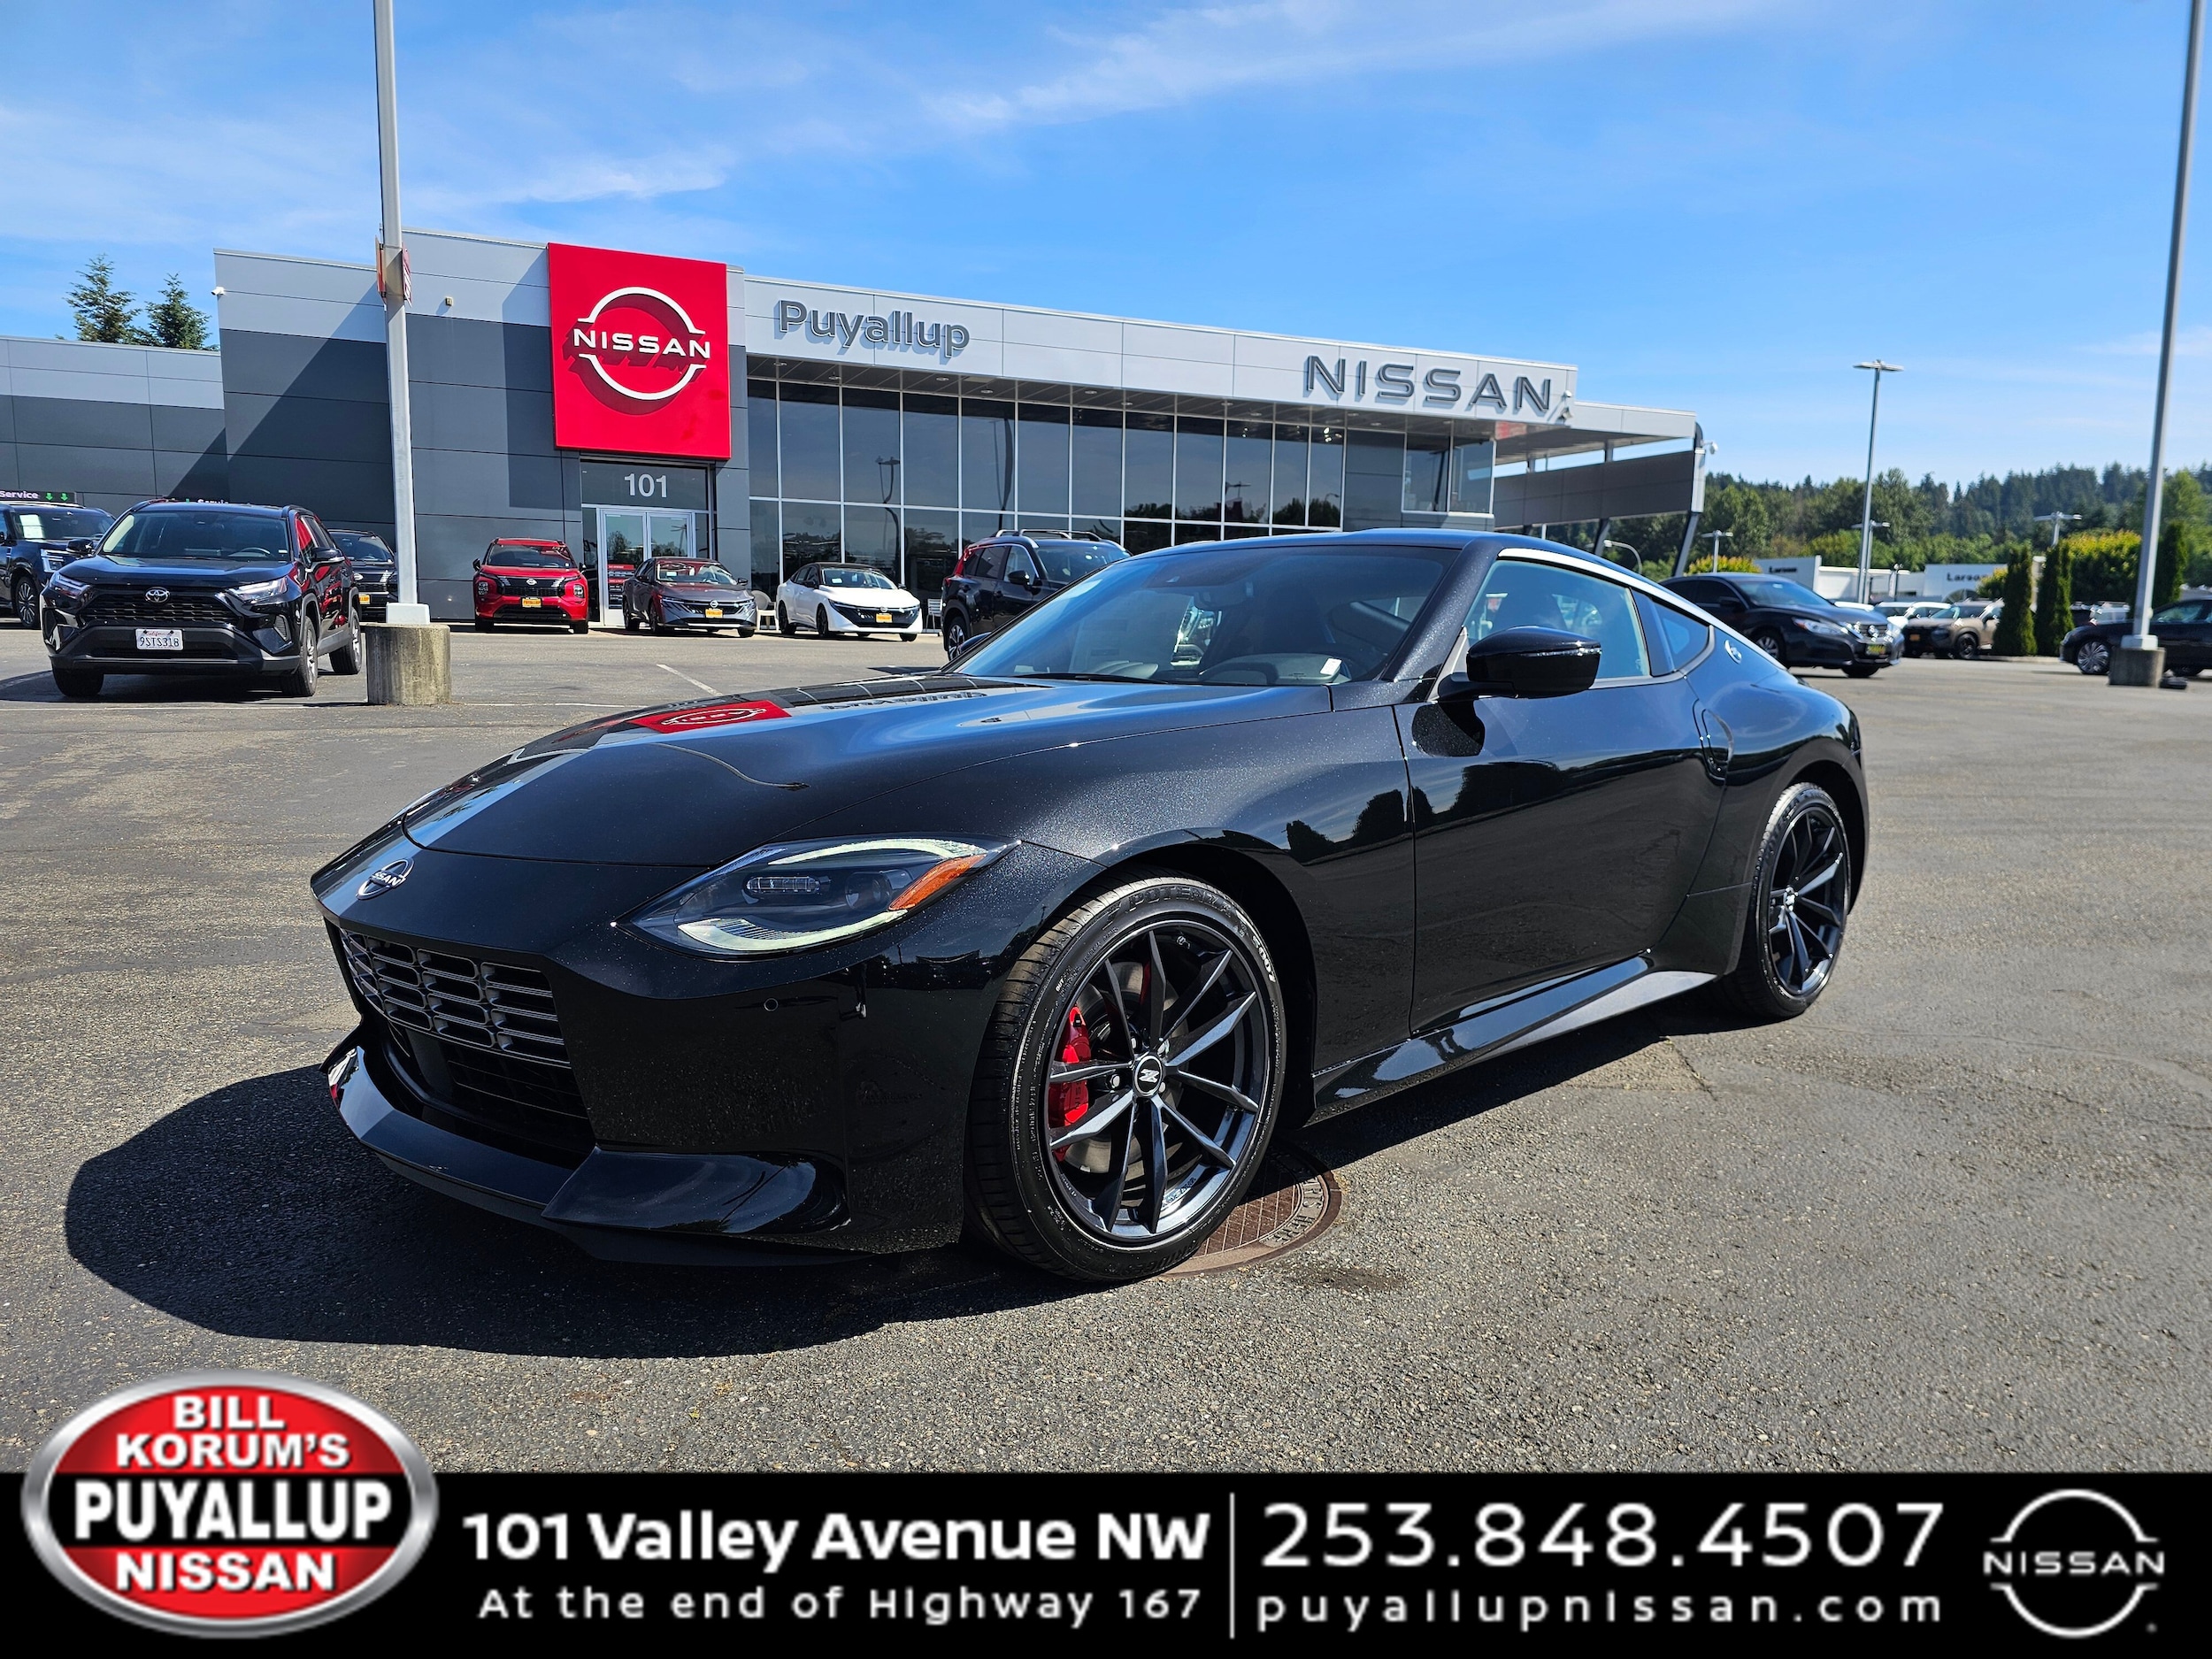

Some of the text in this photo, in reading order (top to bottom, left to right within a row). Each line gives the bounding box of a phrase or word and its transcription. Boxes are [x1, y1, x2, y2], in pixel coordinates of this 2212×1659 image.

[573, 328, 710, 359] NISSAN
[779, 300, 971, 358] Puyallup
[1306, 355, 1552, 412] NISSAN
[0, 490, 39, 499] Service
[624, 473, 668, 498] 101
